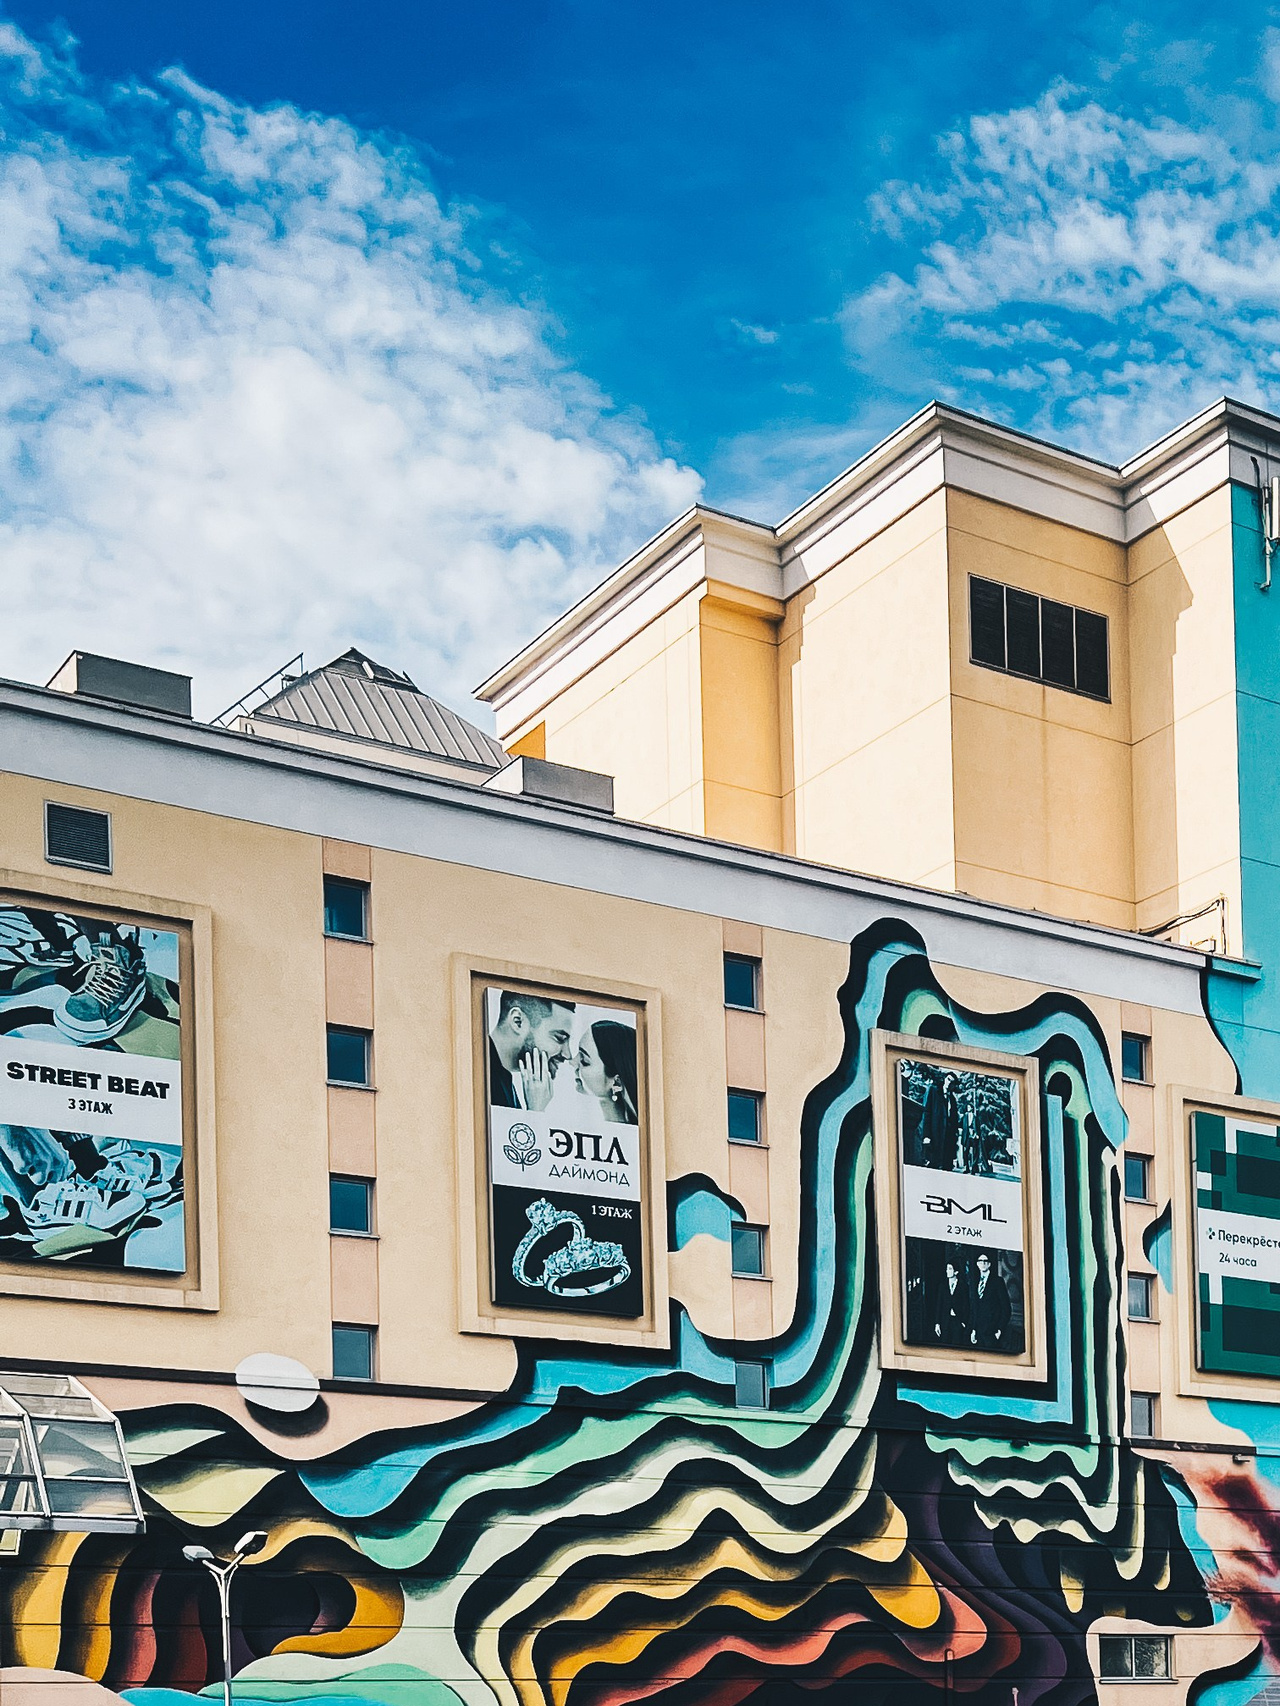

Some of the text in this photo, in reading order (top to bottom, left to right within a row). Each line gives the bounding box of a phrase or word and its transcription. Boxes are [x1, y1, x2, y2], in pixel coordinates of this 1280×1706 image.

[6, 1061, 170, 1099] STREET BEAT
[68, 1098, 114, 1115] 3 ЭТАЖ
[548, 1128, 630, 1166] ЭПЛ
[548, 1163, 631, 1187] ДАЙМОНД
[591, 1204, 633, 1220] 1 ЭТАЖ
[919, 1194, 1008, 1224] BML
[946, 1224, 983, 1238] 2 ЭТАЖ
[1219, 1252, 1258, 1268] 24 часа
